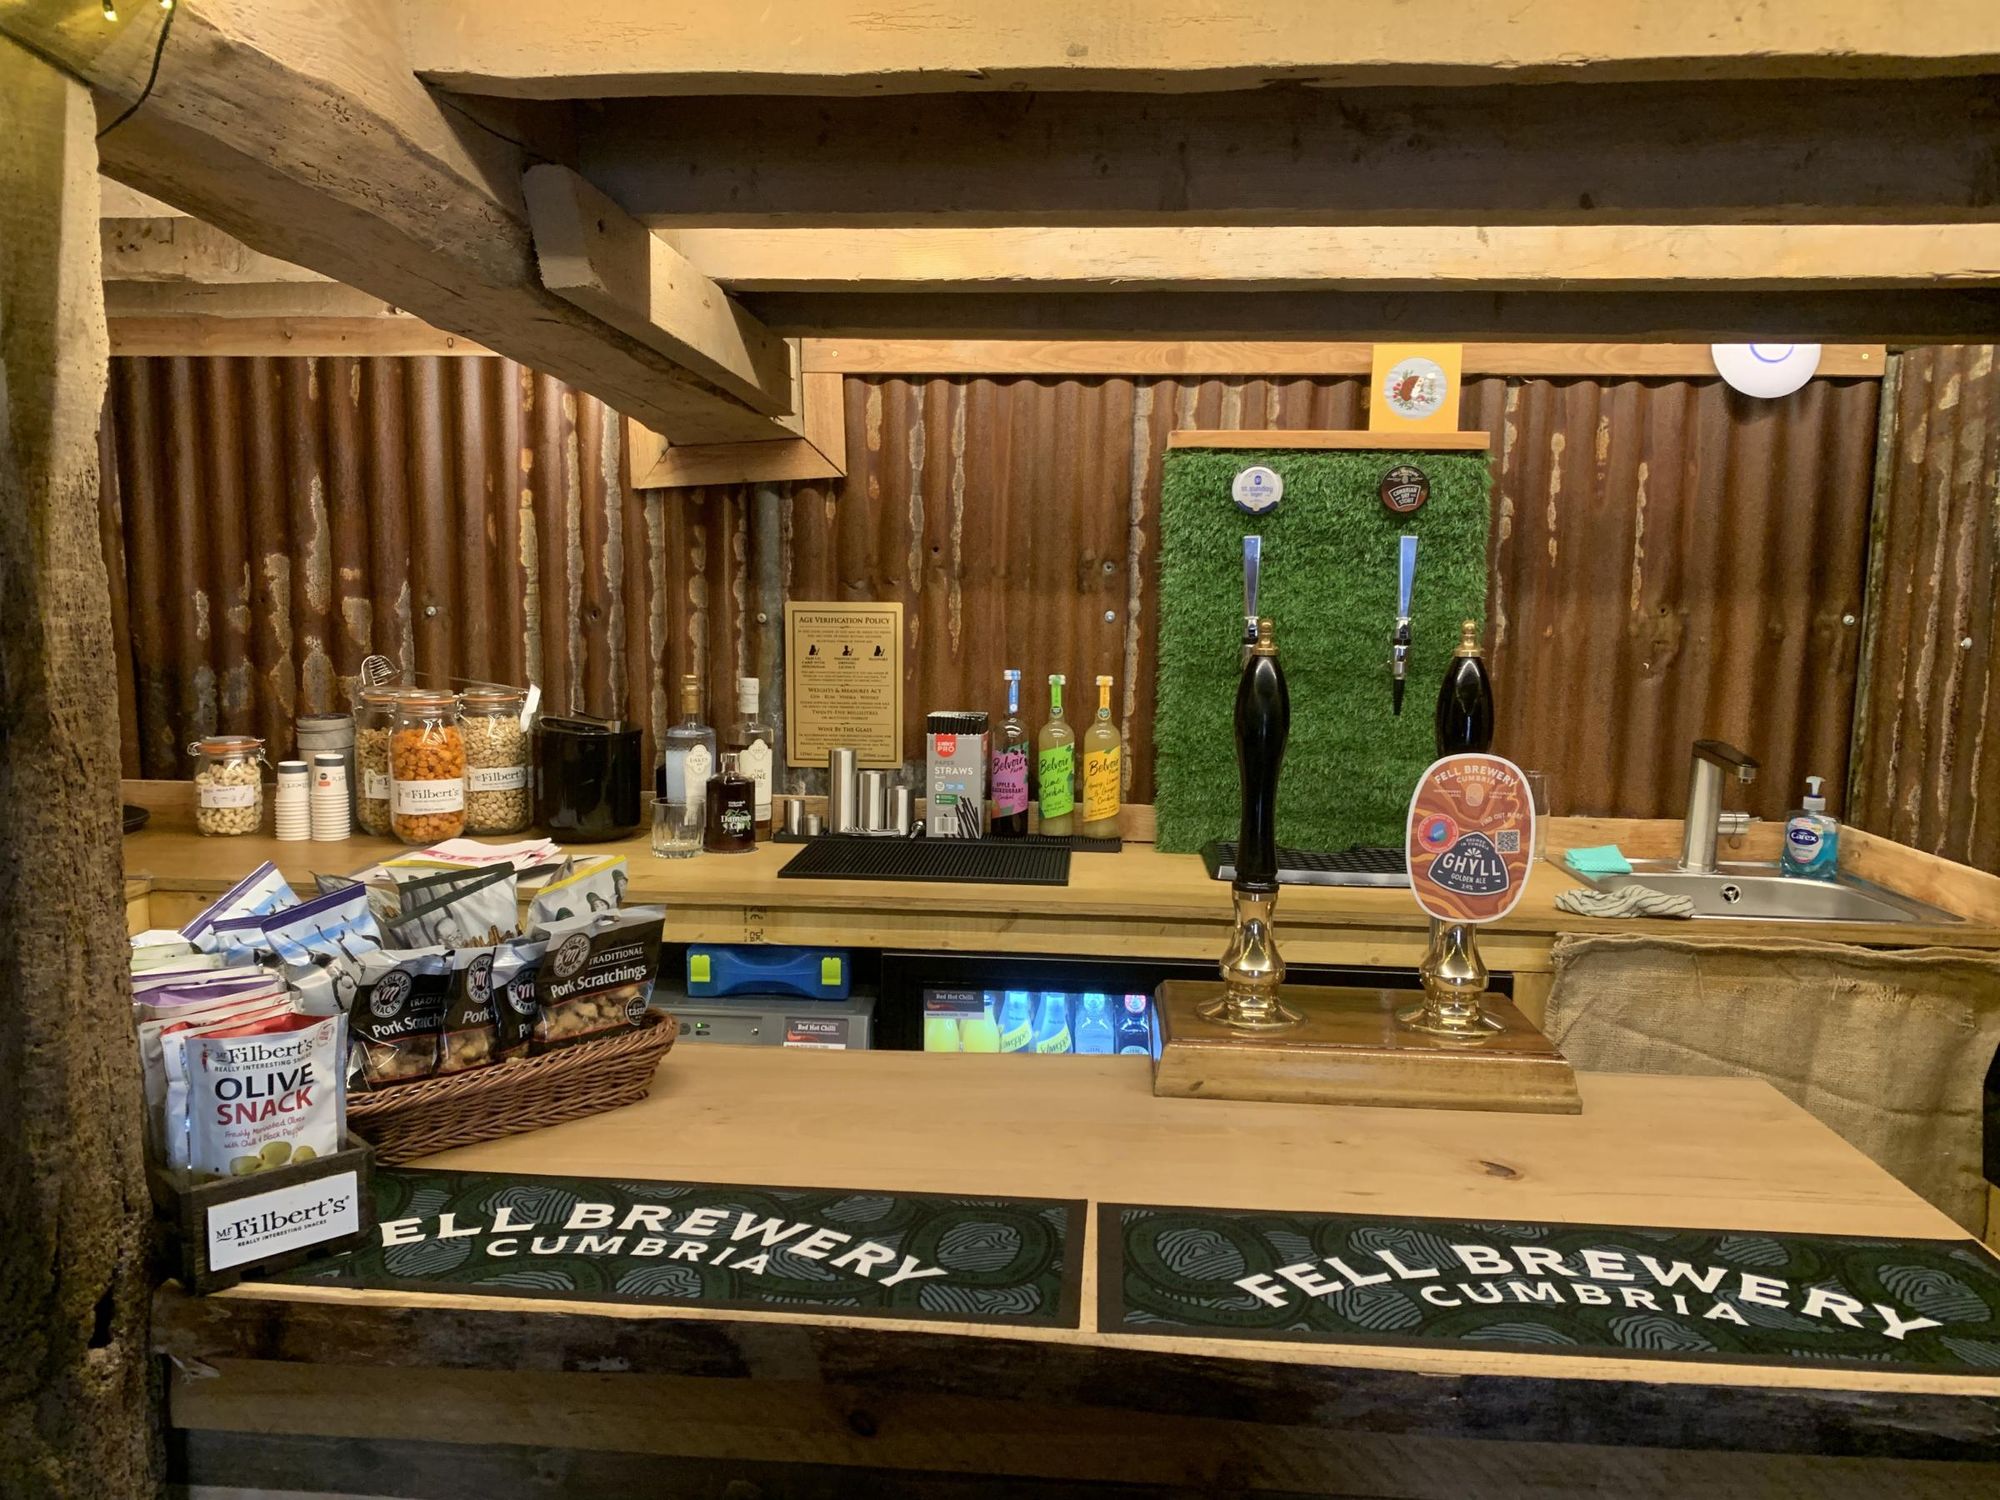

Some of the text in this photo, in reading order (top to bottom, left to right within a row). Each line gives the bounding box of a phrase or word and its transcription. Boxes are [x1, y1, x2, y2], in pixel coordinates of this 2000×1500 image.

[798, 616, 890, 625] AGE VERIFICATION POLICY
[934, 766, 974, 776] STRAWS
[1040, 757, 1070, 775] Belvoir
[1089, 759, 1120, 777] Belvoir
[1434, 764, 1519, 788] FELL BREWERY
[1456, 776, 1496, 786] CUMBRIA
[412, 788, 460, 800] Filbert's
[1790, 832, 1817, 842] Carex
[1442, 853, 1502, 877] GHYLL
[1450, 872, 1486, 884] GOLDEN ALE
[588, 946, 644, 966] TRADITIONAL
[550, 964, 647, 998] Pork Scratchings
[372, 1013, 444, 1038] Pork Scratch
[462, 1009, 490, 1024] Pork
[226, 1038, 314, 1064] Filbert's
[242, 1059, 292, 1071] INTERESTING
[214, 1063, 314, 1101] OLIVE
[216, 1086, 313, 1126] SNACK
[232, 1197, 346, 1241] Filbert's
[238, 1219, 327, 1248] REALLY INTERESTING SNACKS
[379, 1203, 948, 1288] ELL BREWERY
[486, 1236, 770, 1276] CUMBRIA
[1234, 1244, 1945, 1341] FELL BREWERY
[1420, 1280, 1750, 1326] CUMBRIA
